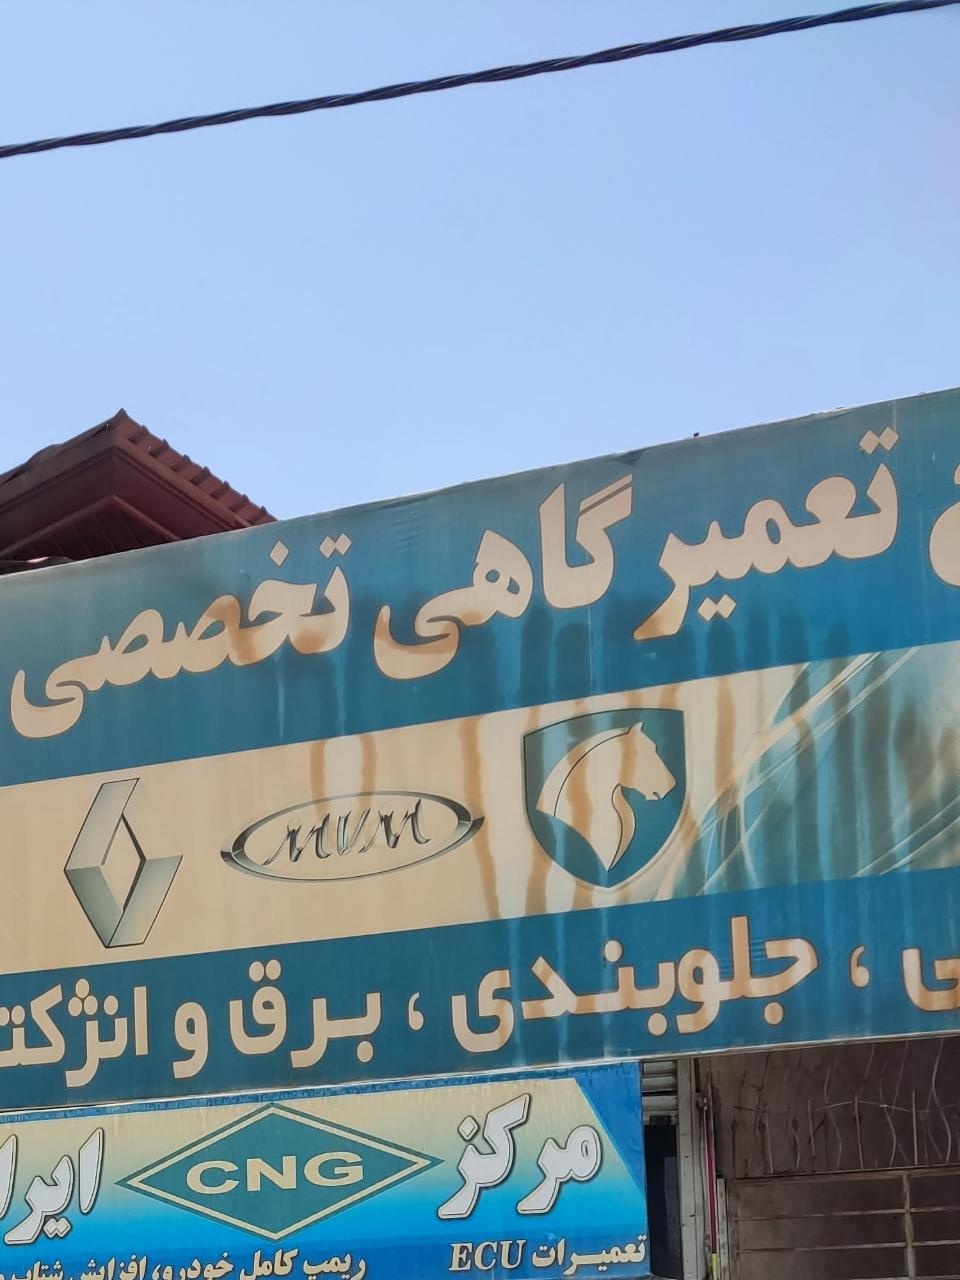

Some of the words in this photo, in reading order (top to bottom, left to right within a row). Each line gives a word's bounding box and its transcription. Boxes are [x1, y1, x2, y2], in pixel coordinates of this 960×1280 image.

[9, 532, 352, 739] تخصصی
[262, 798, 432, 863] MVM
[229, 958, 382, 1068] برق
[451, 916, 819, 1054] جلوبندی
[172, 1002, 209, 1079] و
[186, 1151, 365, 1195] CNG
[436, 1092, 604, 1219] مرکز
[448, 1240, 528, 1272] ECU
[531, 1235, 649, 1277] تعمیرات
